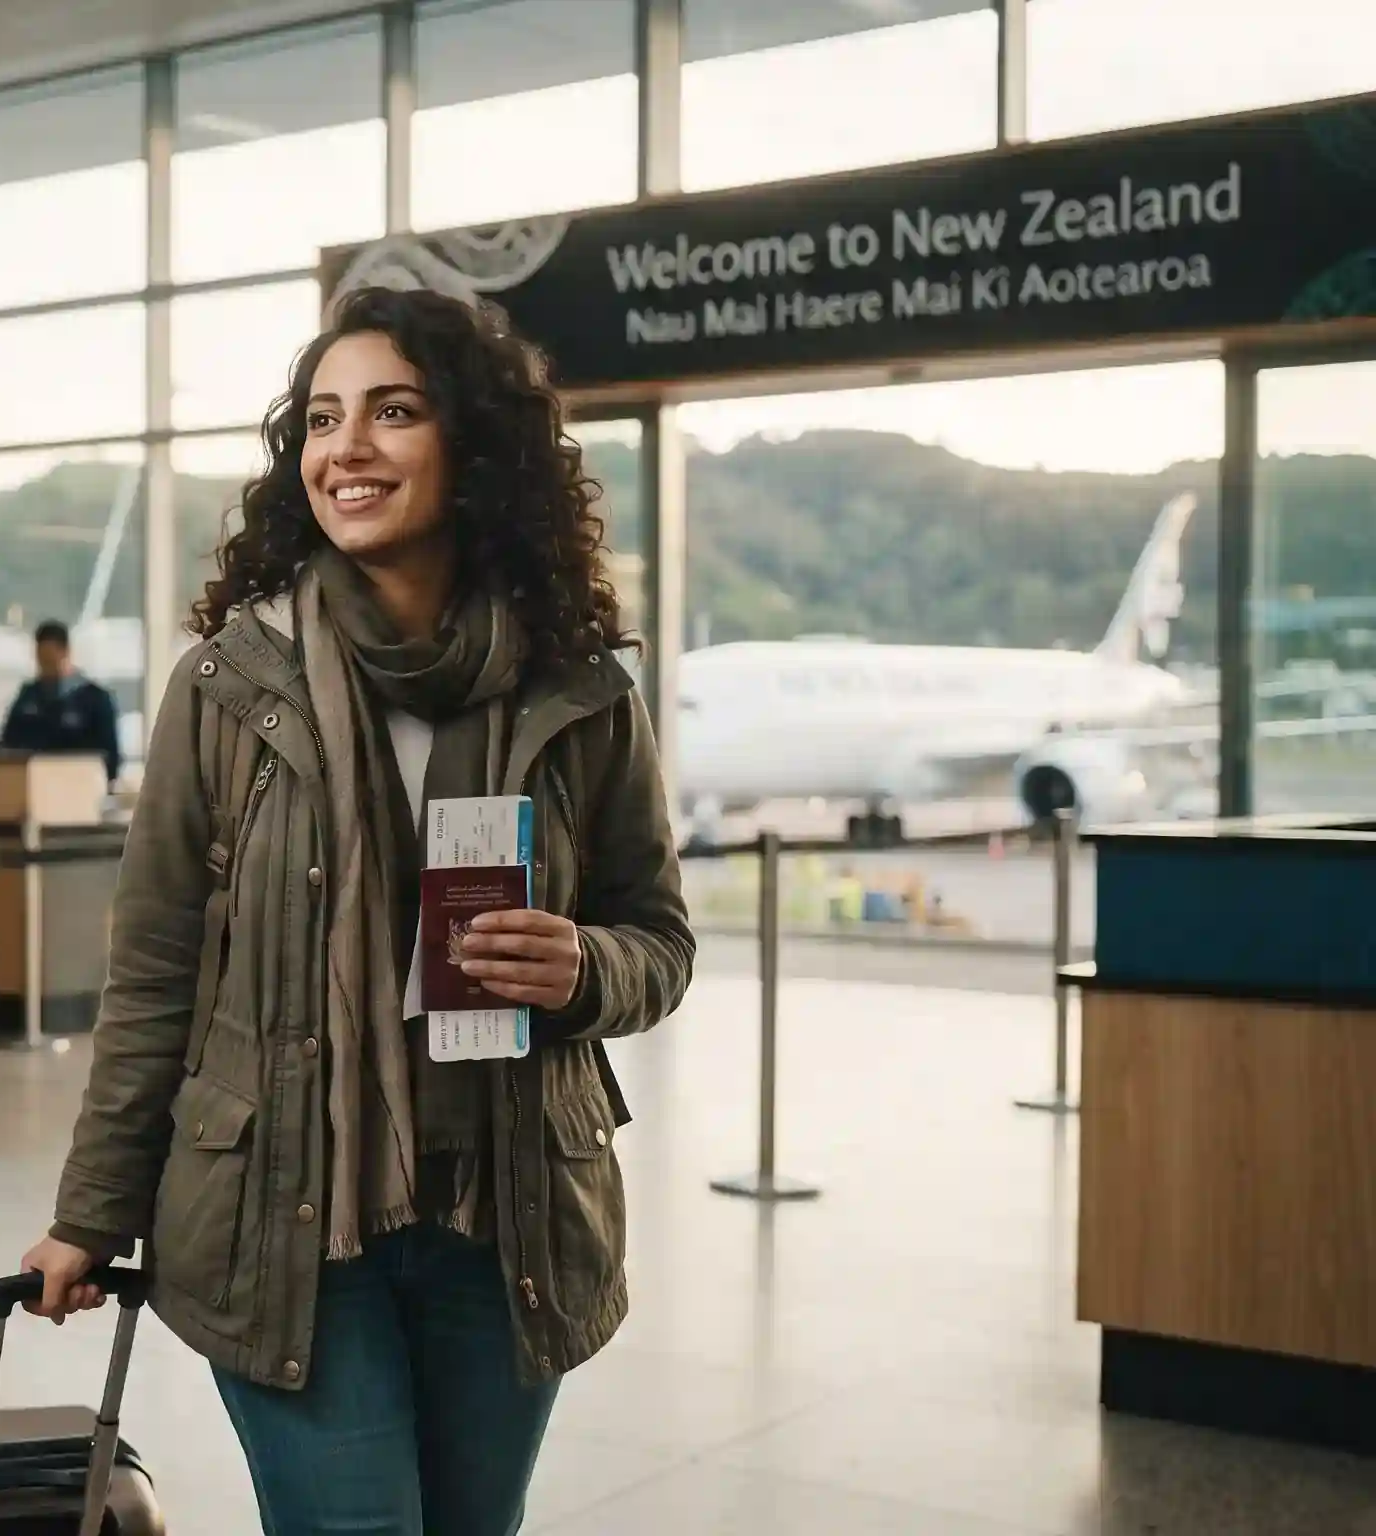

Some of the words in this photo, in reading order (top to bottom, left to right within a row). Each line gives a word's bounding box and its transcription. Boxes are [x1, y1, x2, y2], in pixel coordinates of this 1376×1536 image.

[606, 232, 816, 292] Welcome
[826, 222, 880, 269] to
[891, 206, 1007, 261] New
[1019, 160, 1242, 246] Zealand
[626, 306, 696, 344] Nau
[775, 289, 884, 331] Haere
[892, 270, 962, 319] Mai
[1018, 252, 1212, 306] Aotearoa
